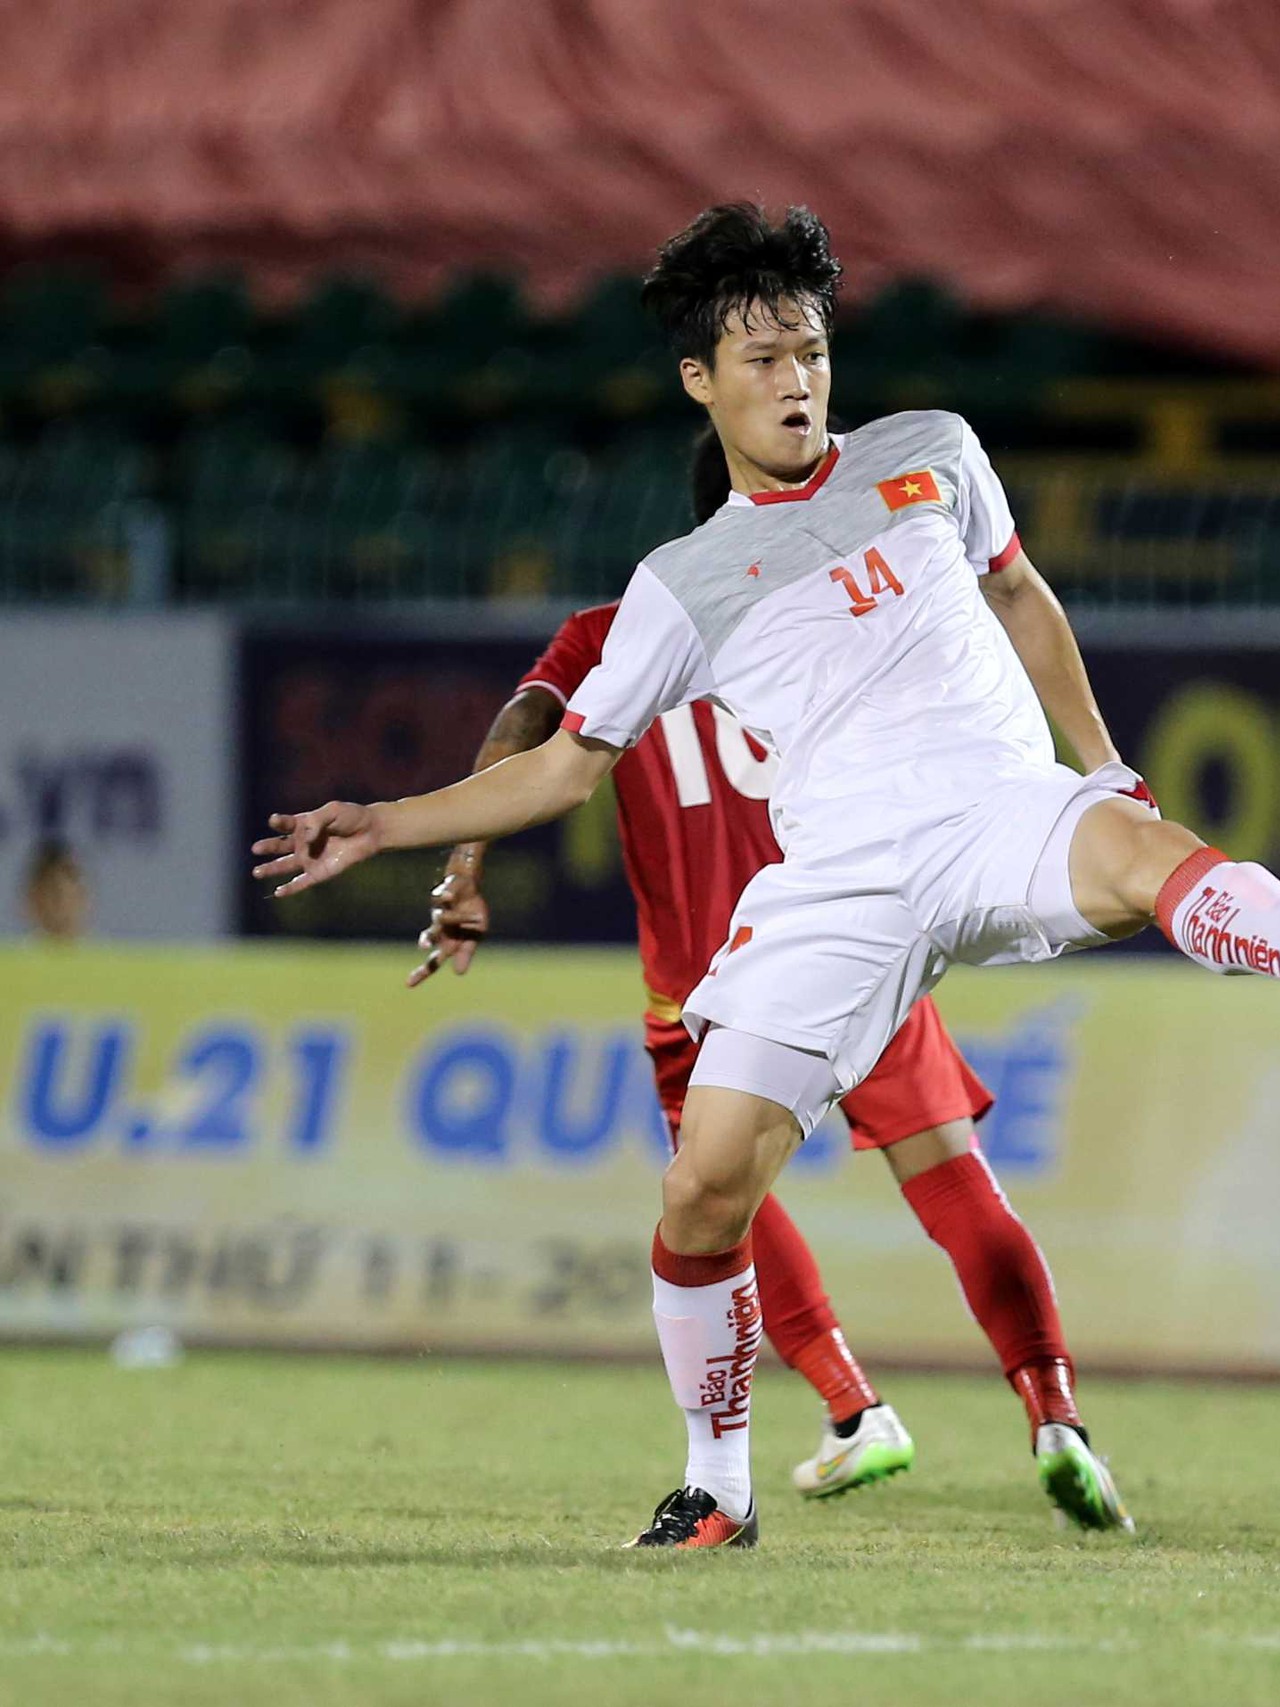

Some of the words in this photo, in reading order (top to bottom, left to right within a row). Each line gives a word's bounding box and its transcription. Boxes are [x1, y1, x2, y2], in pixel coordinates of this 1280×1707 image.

[829, 546, 905, 617] 14
[22, 1020, 352, 1152] U.21
[699, 1370, 727, 1407] Báo
